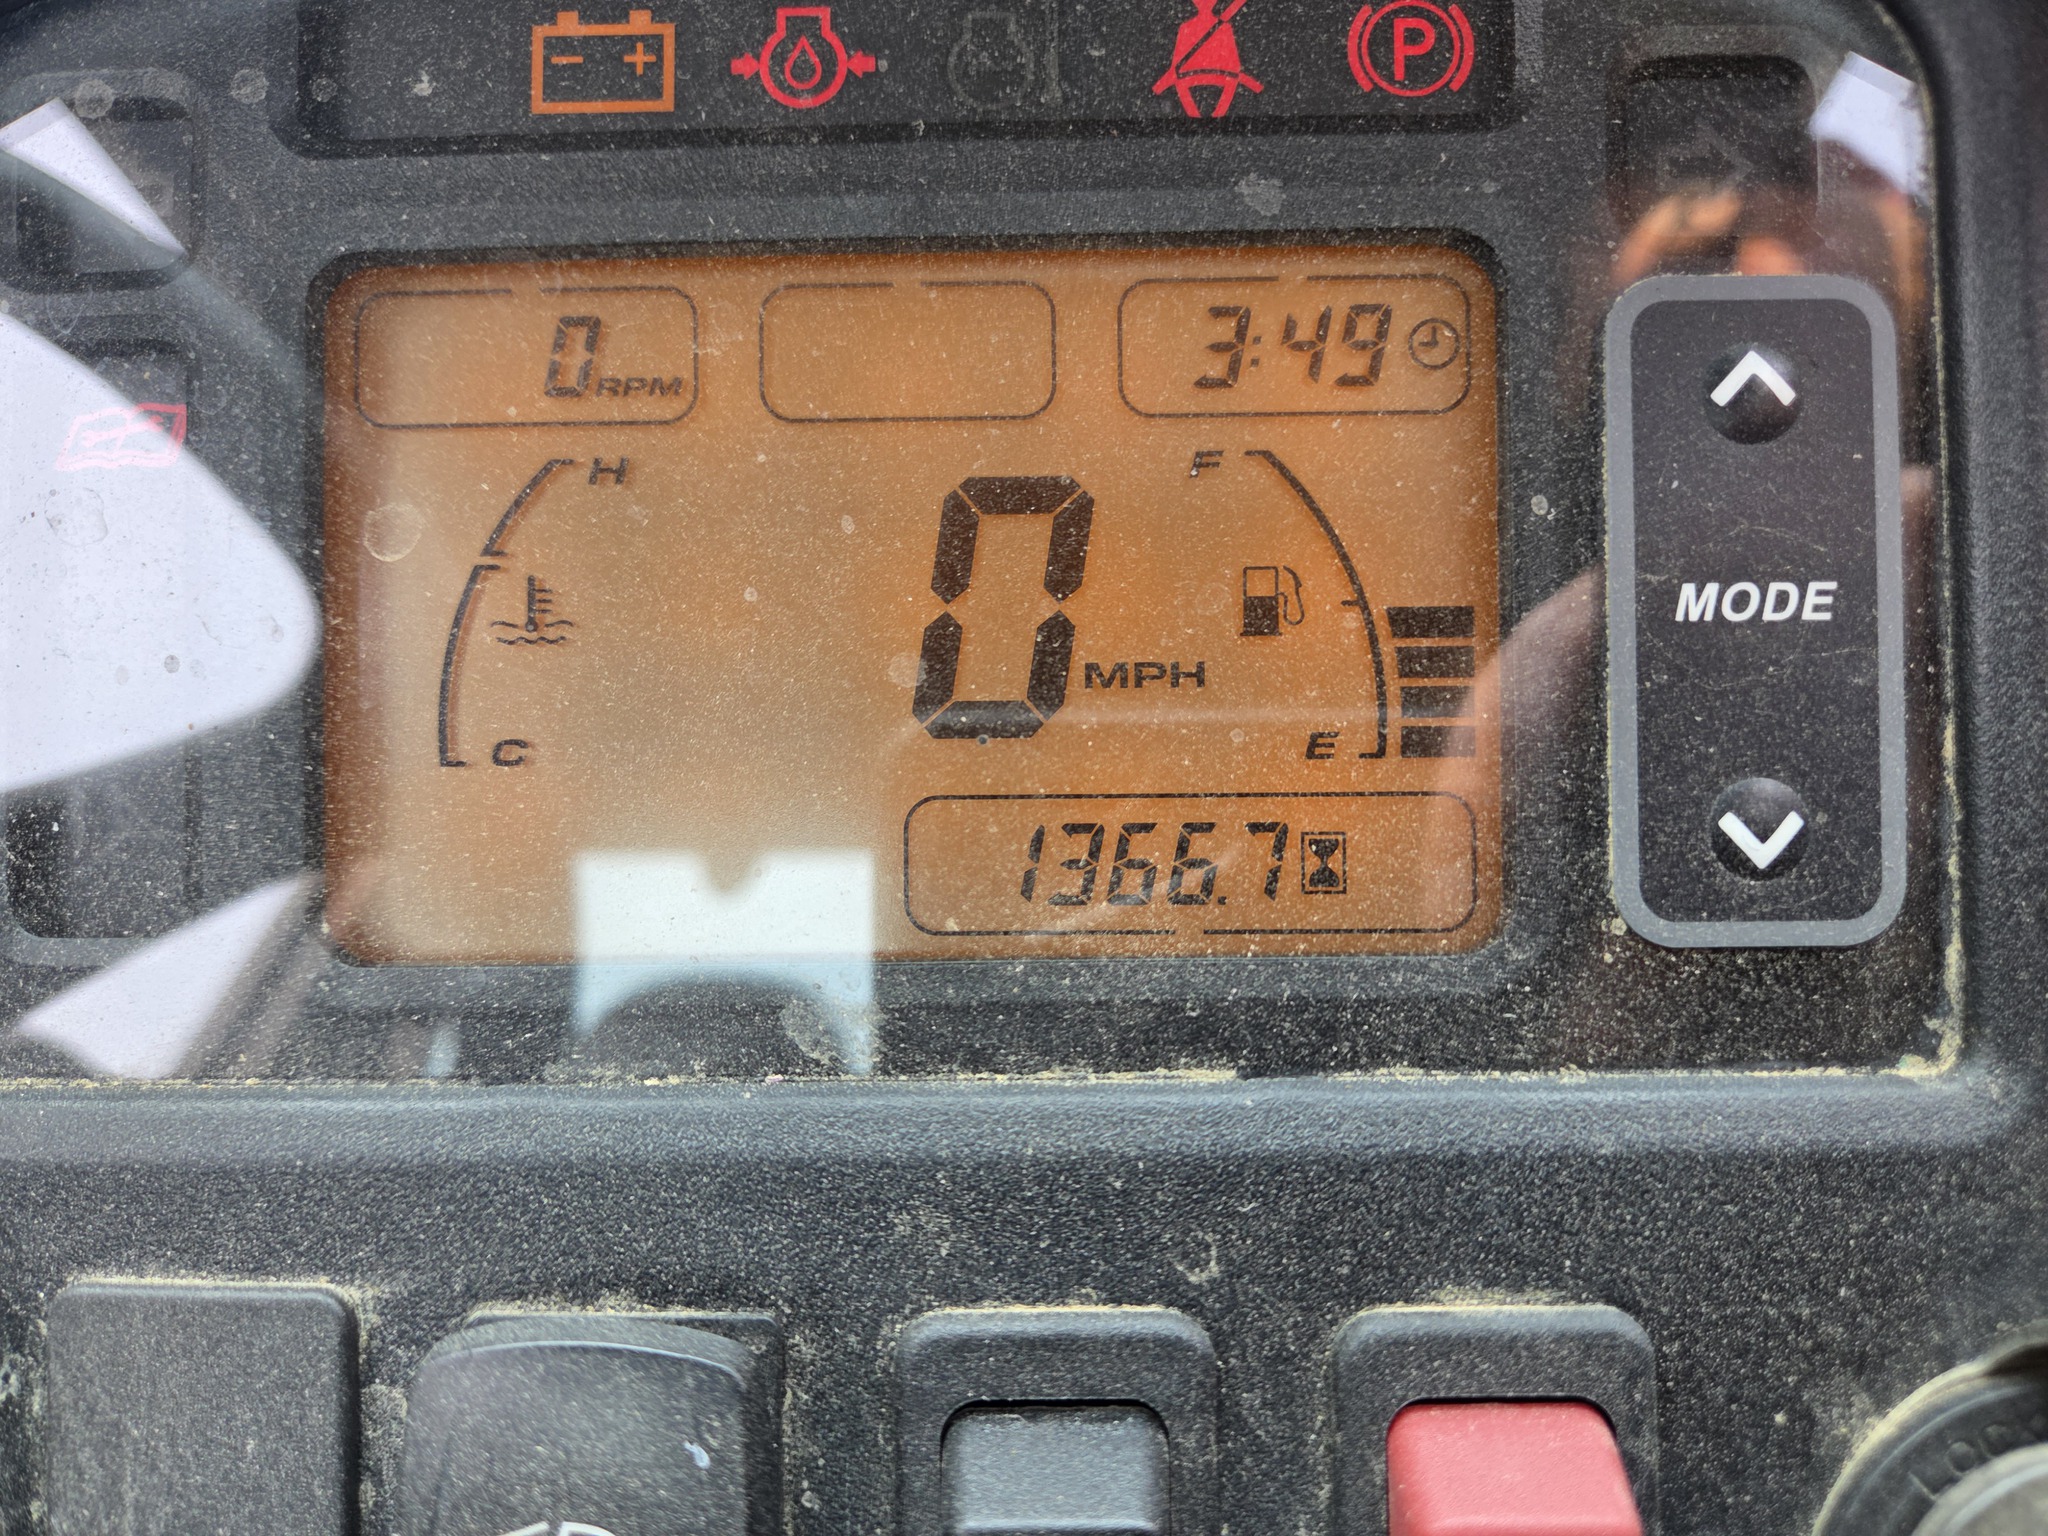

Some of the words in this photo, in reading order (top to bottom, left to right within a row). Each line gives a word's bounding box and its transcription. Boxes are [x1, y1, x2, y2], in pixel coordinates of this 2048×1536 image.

[1393, 18, 1435, 80] P
[545, 316, 601, 397] 0
[598, 378, 683, 398] RPM
[1194, 304, 1393, 388] 3:49
[588, 457, 629, 485] H
[1190, 450, 1225, 478] F
[911, 475, 1095, 739] 0
[1084, 662, 1206, 689] MPH
[1674, 581, 1838, 622] MODE
[492, 738, 528, 767] C
[1305, 732, 1340, 759] E
[1020, 822, 1289, 906] 1366.7
